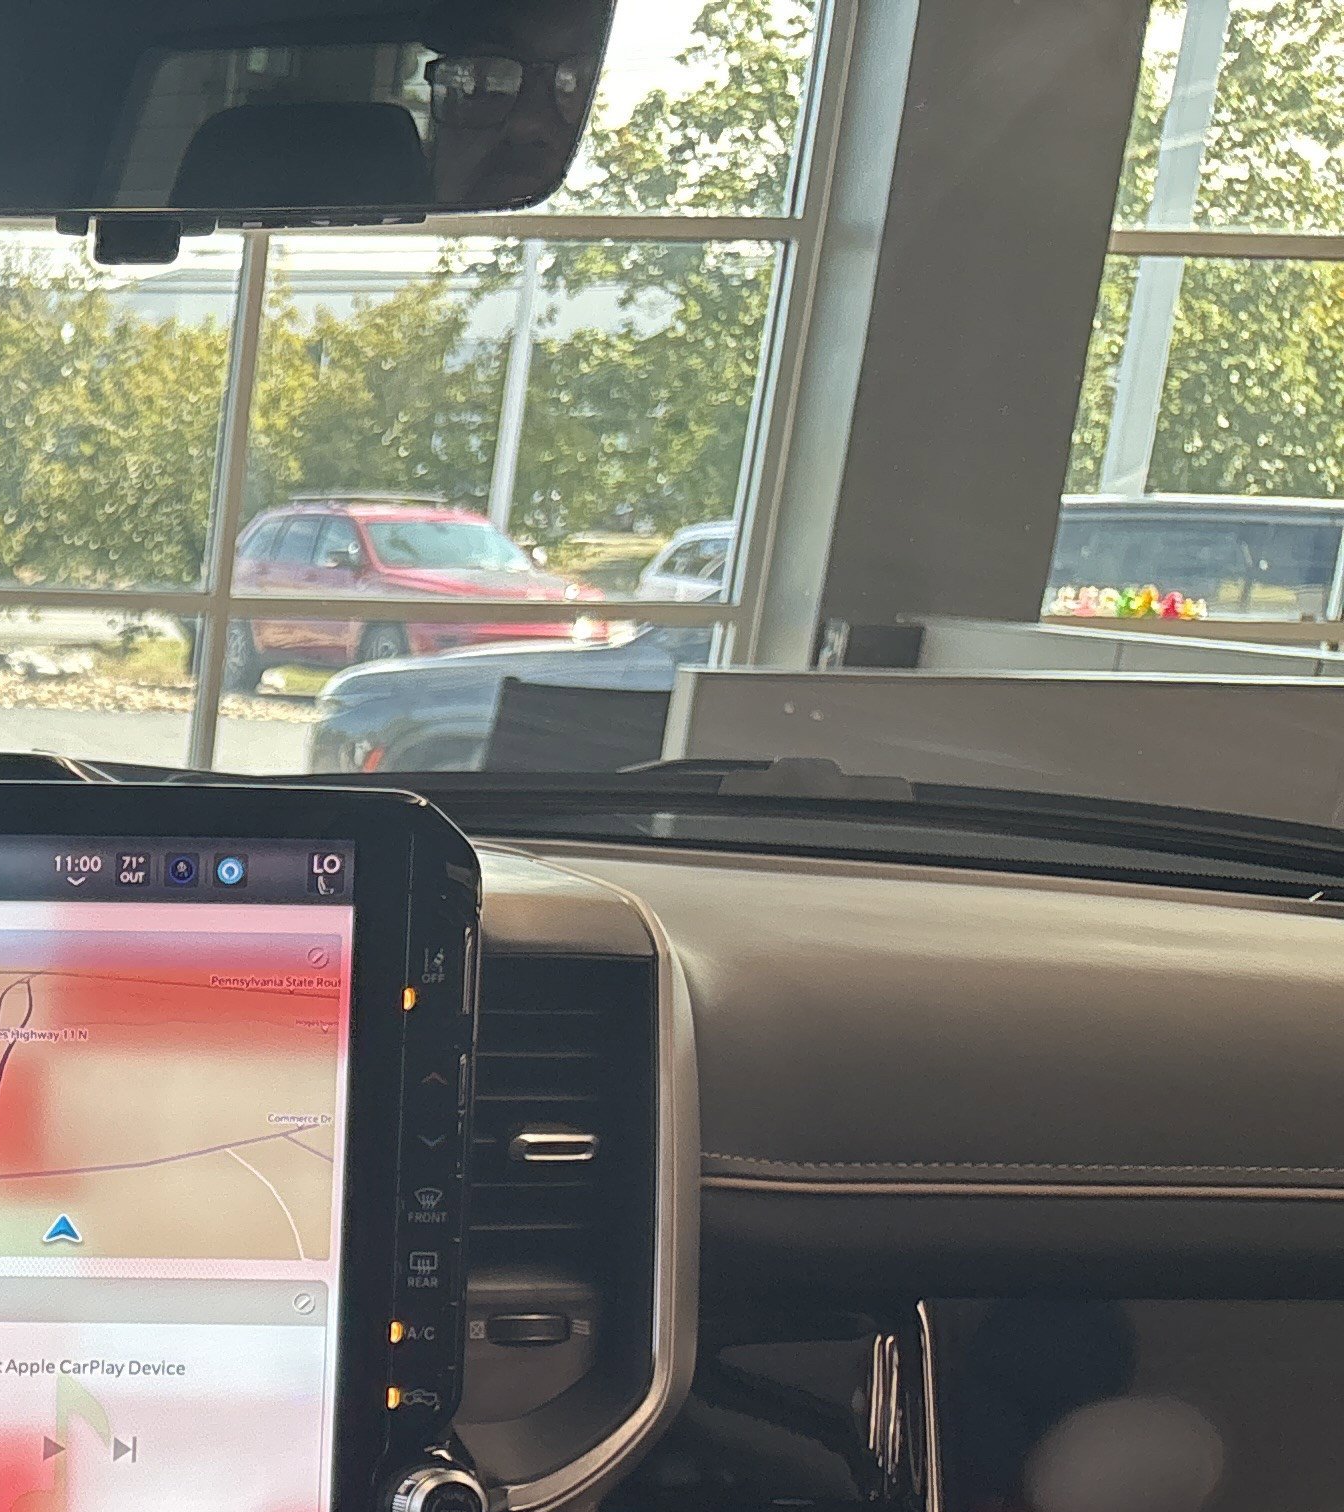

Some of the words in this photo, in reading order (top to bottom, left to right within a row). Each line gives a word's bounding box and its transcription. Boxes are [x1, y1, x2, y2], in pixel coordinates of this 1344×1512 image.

[54, 855, 102, 873] 11:00
[313, 855, 341, 875] LO
[120, 870, 146, 885] OUT
[211, 976, 282, 989] Pennsylvania
[285, 976, 313, 988] State
[422, 973, 445, 984] OFF
[11, 1028, 60, 1043] Highway
[267, 1113, 318, 1123] Commerce
[320, 1114, 332, 1123] Dr
[408, 1212, 447, 1223] FRONT
[407, 1276, 439, 1288] REAR
[407, 1327, 436, 1341] A/C
[5, 1358, 56, 1378] Apple
[59, 1358, 125, 1379] CarPlay
[128, 1359, 186, 1378] Device
